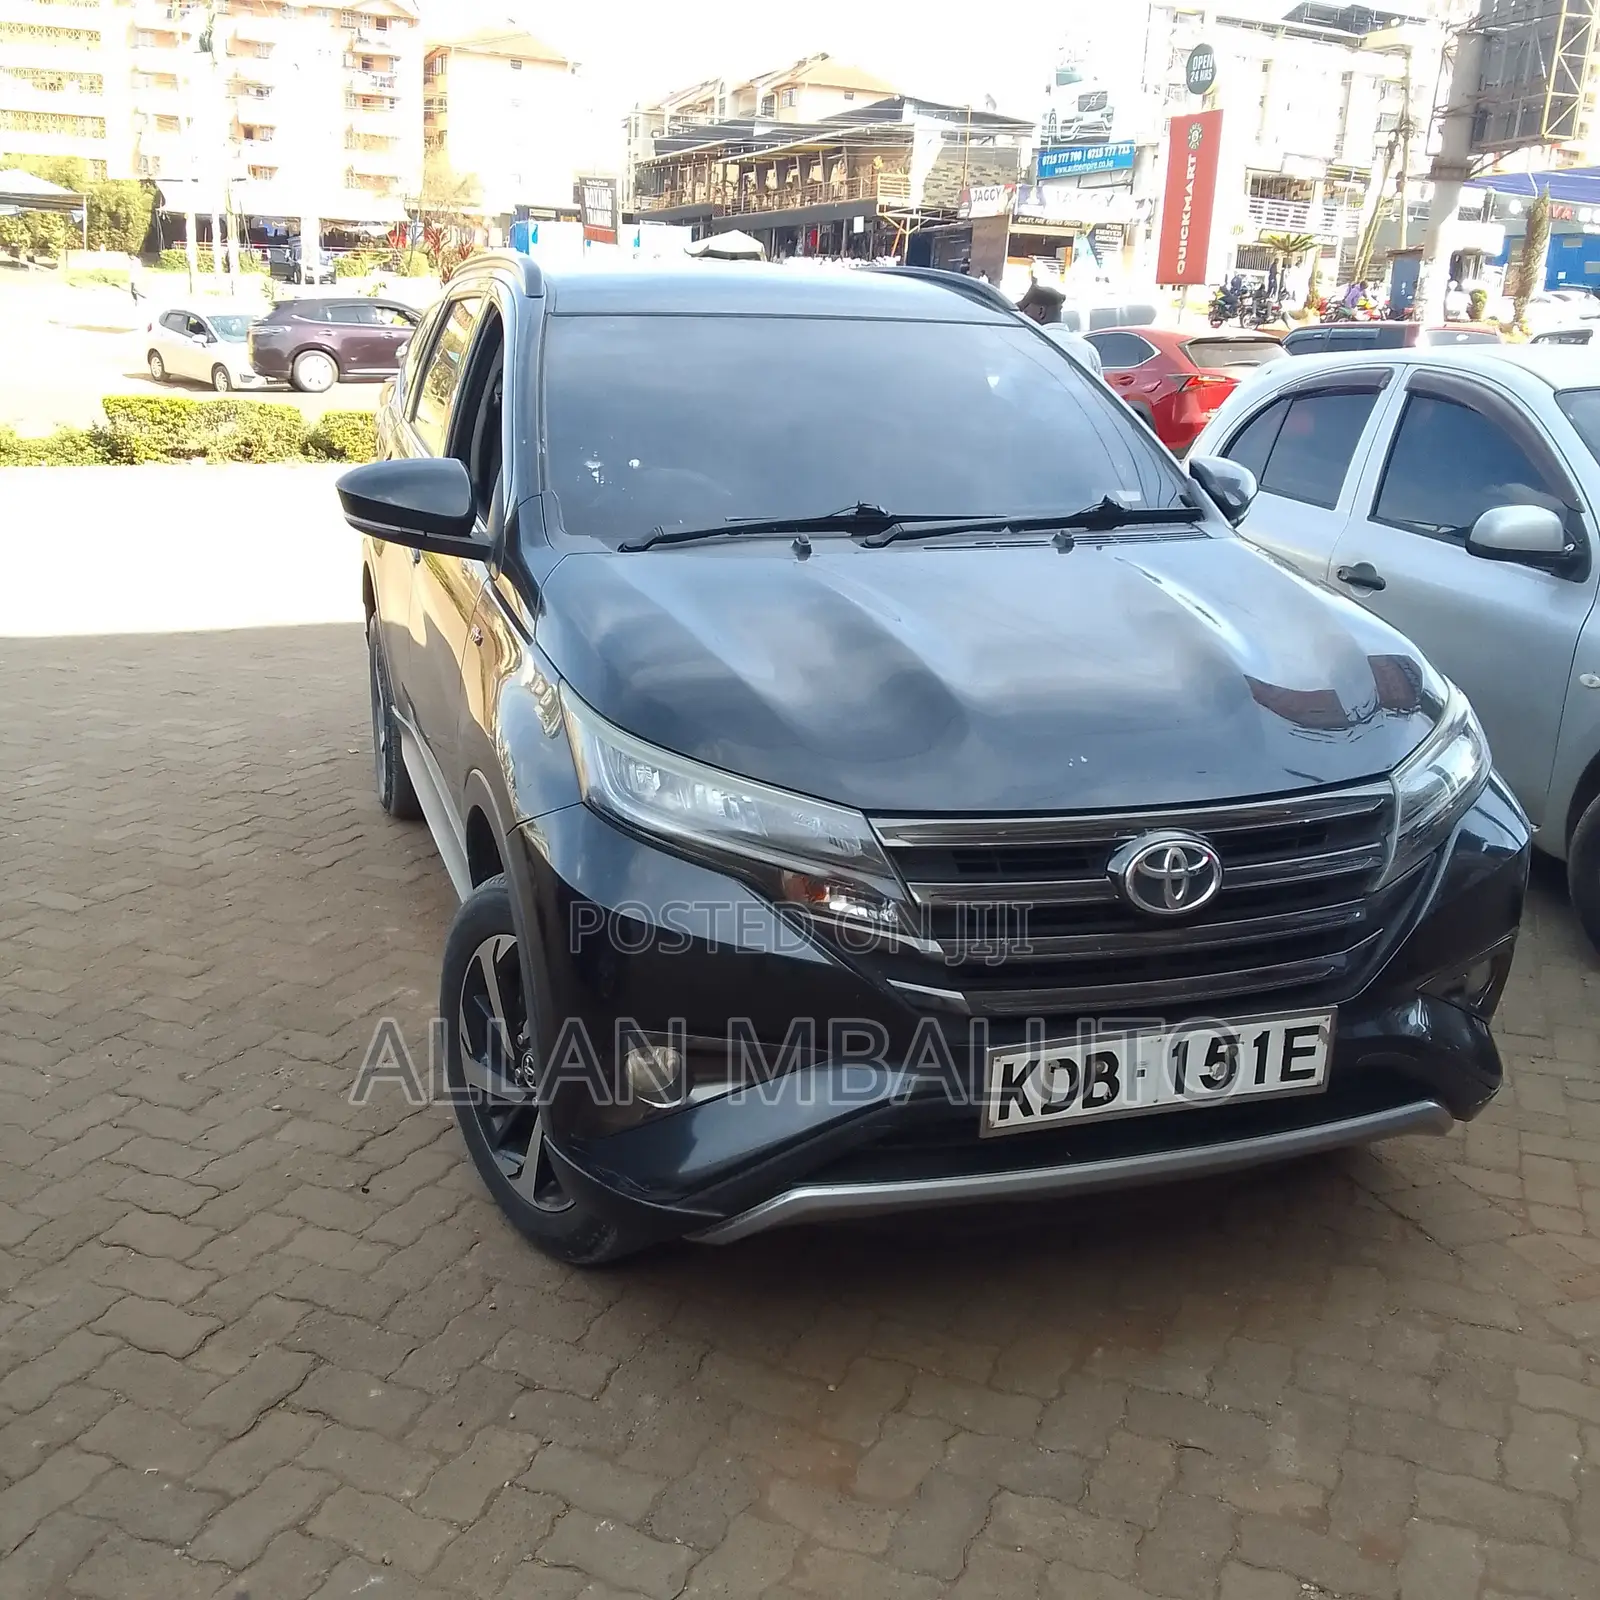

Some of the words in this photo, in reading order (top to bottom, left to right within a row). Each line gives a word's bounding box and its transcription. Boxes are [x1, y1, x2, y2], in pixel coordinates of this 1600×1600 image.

[1190, 70, 1200, 83] 24
[1193, 54, 1214, 71] OPEN
[1177, 153, 1197, 275] QUICKMART
[997, 1049, 1121, 1121] KDB
[1171, 1023, 1324, 1096] 151E
